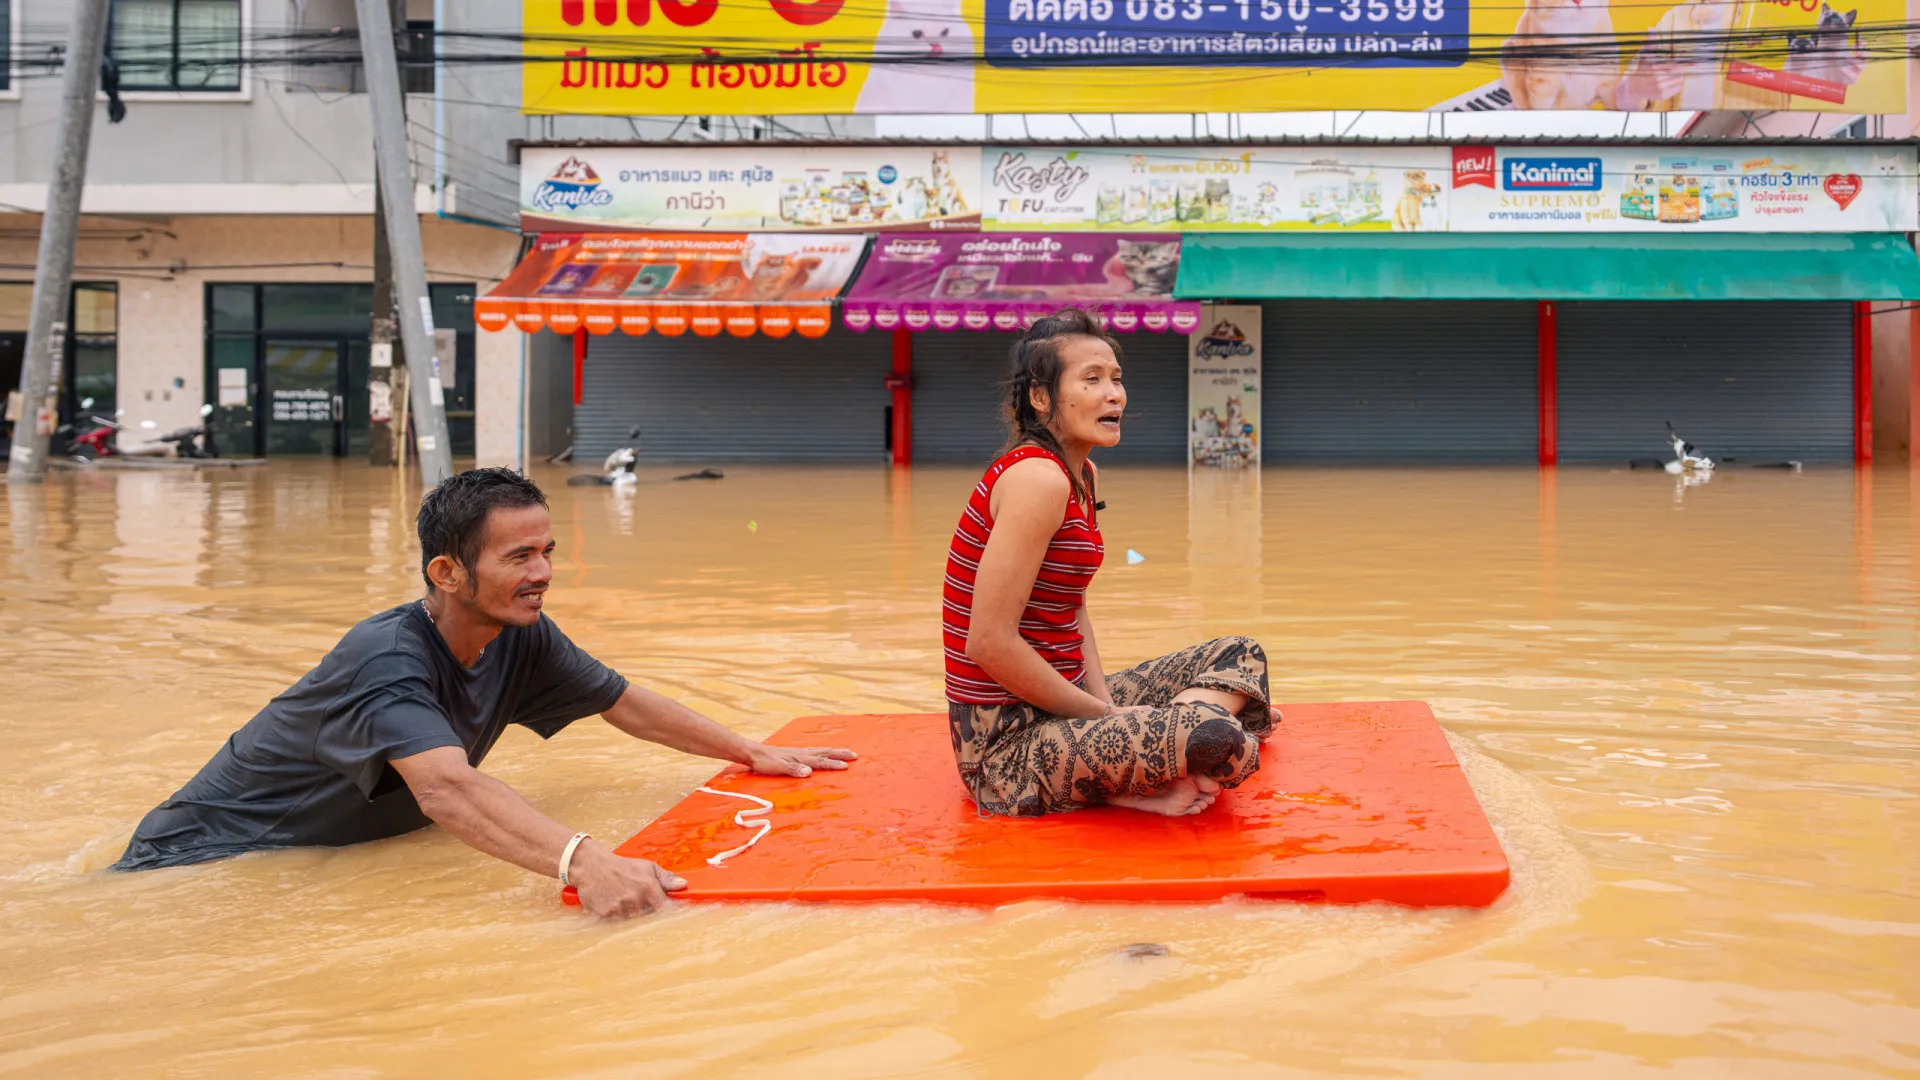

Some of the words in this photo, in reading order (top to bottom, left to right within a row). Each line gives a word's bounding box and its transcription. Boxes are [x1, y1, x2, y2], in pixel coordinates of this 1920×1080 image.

[1126, 0, 1445, 21] 083-150-3598
[619, 168, 702, 182] อาหารแมว
[708, 168, 734, 182] และ
[993, 152, 1089, 202] Kasty
[1511, 162, 1594, 182] Kanimal
[1782, 171, 1793, 187] 3
[533, 182, 613, 212] Kaniva
[666, 190, 725, 210] คานิว่า
[1500, 193, 1601, 207] SUPREMO
